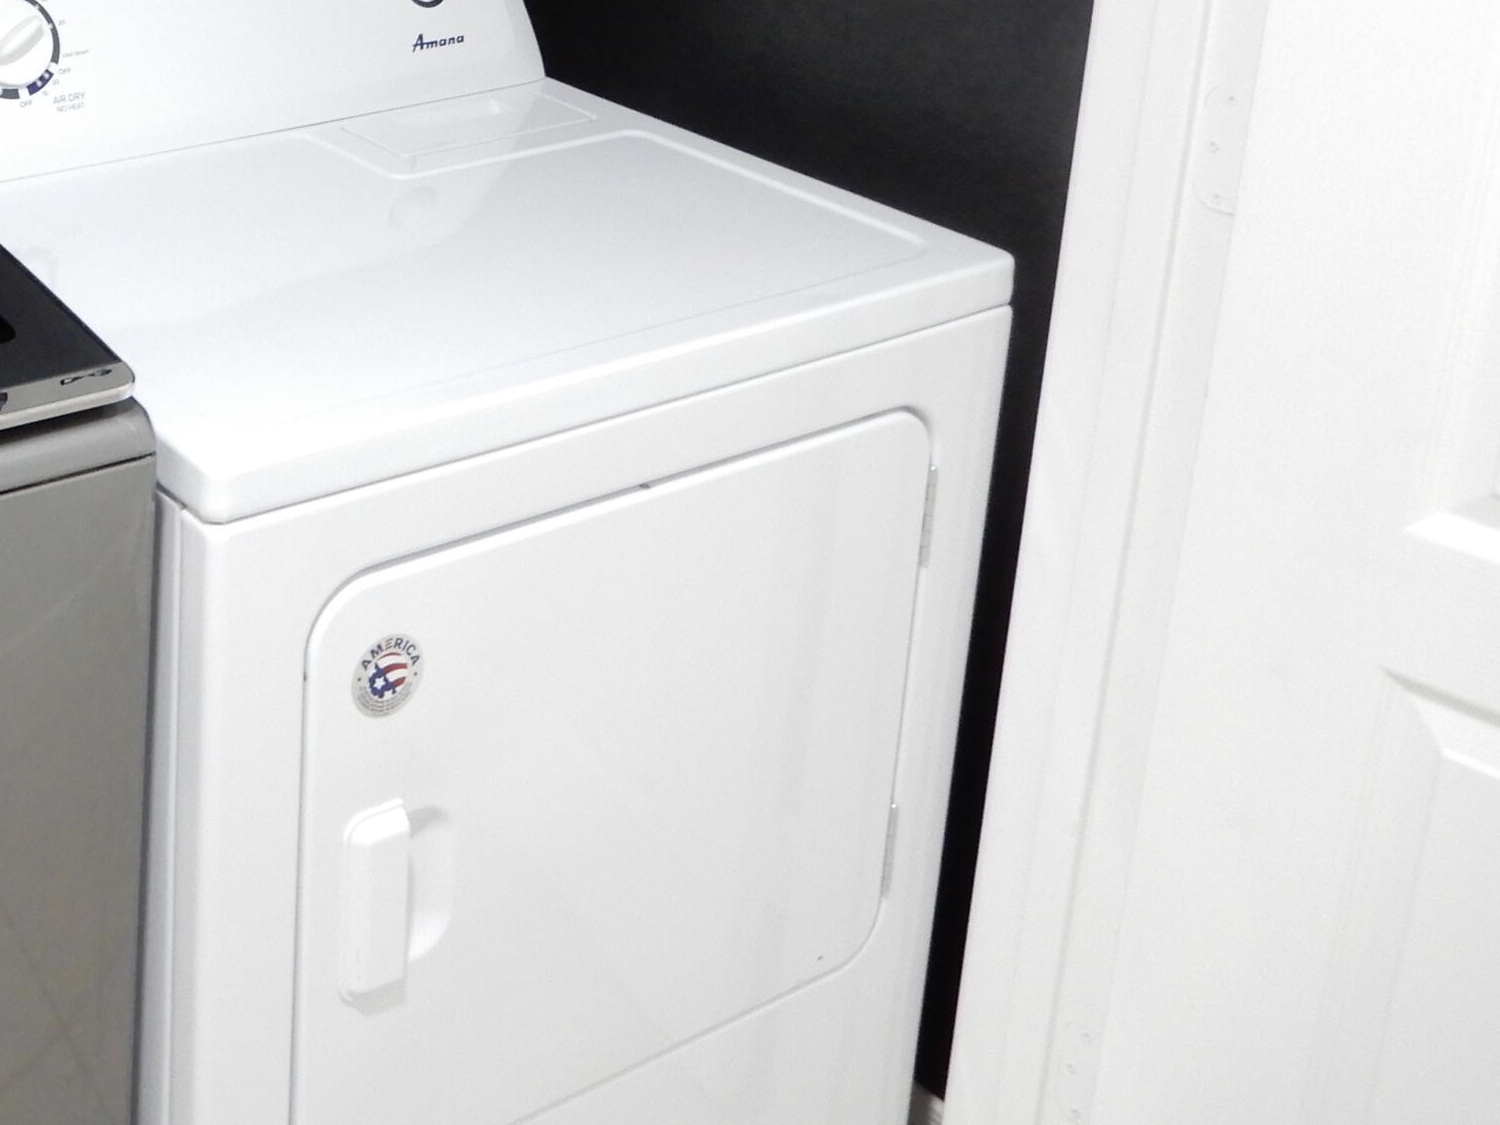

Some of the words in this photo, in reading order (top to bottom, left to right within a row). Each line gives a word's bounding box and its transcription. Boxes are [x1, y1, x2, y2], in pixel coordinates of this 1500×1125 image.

[412, 33, 465, 53] Amana
[19, 99, 33, 108] OFF
[53, 94, 67, 105] AIR
[67, 91, 85, 102] DRY
[361, 637, 421, 671] AMERICA
